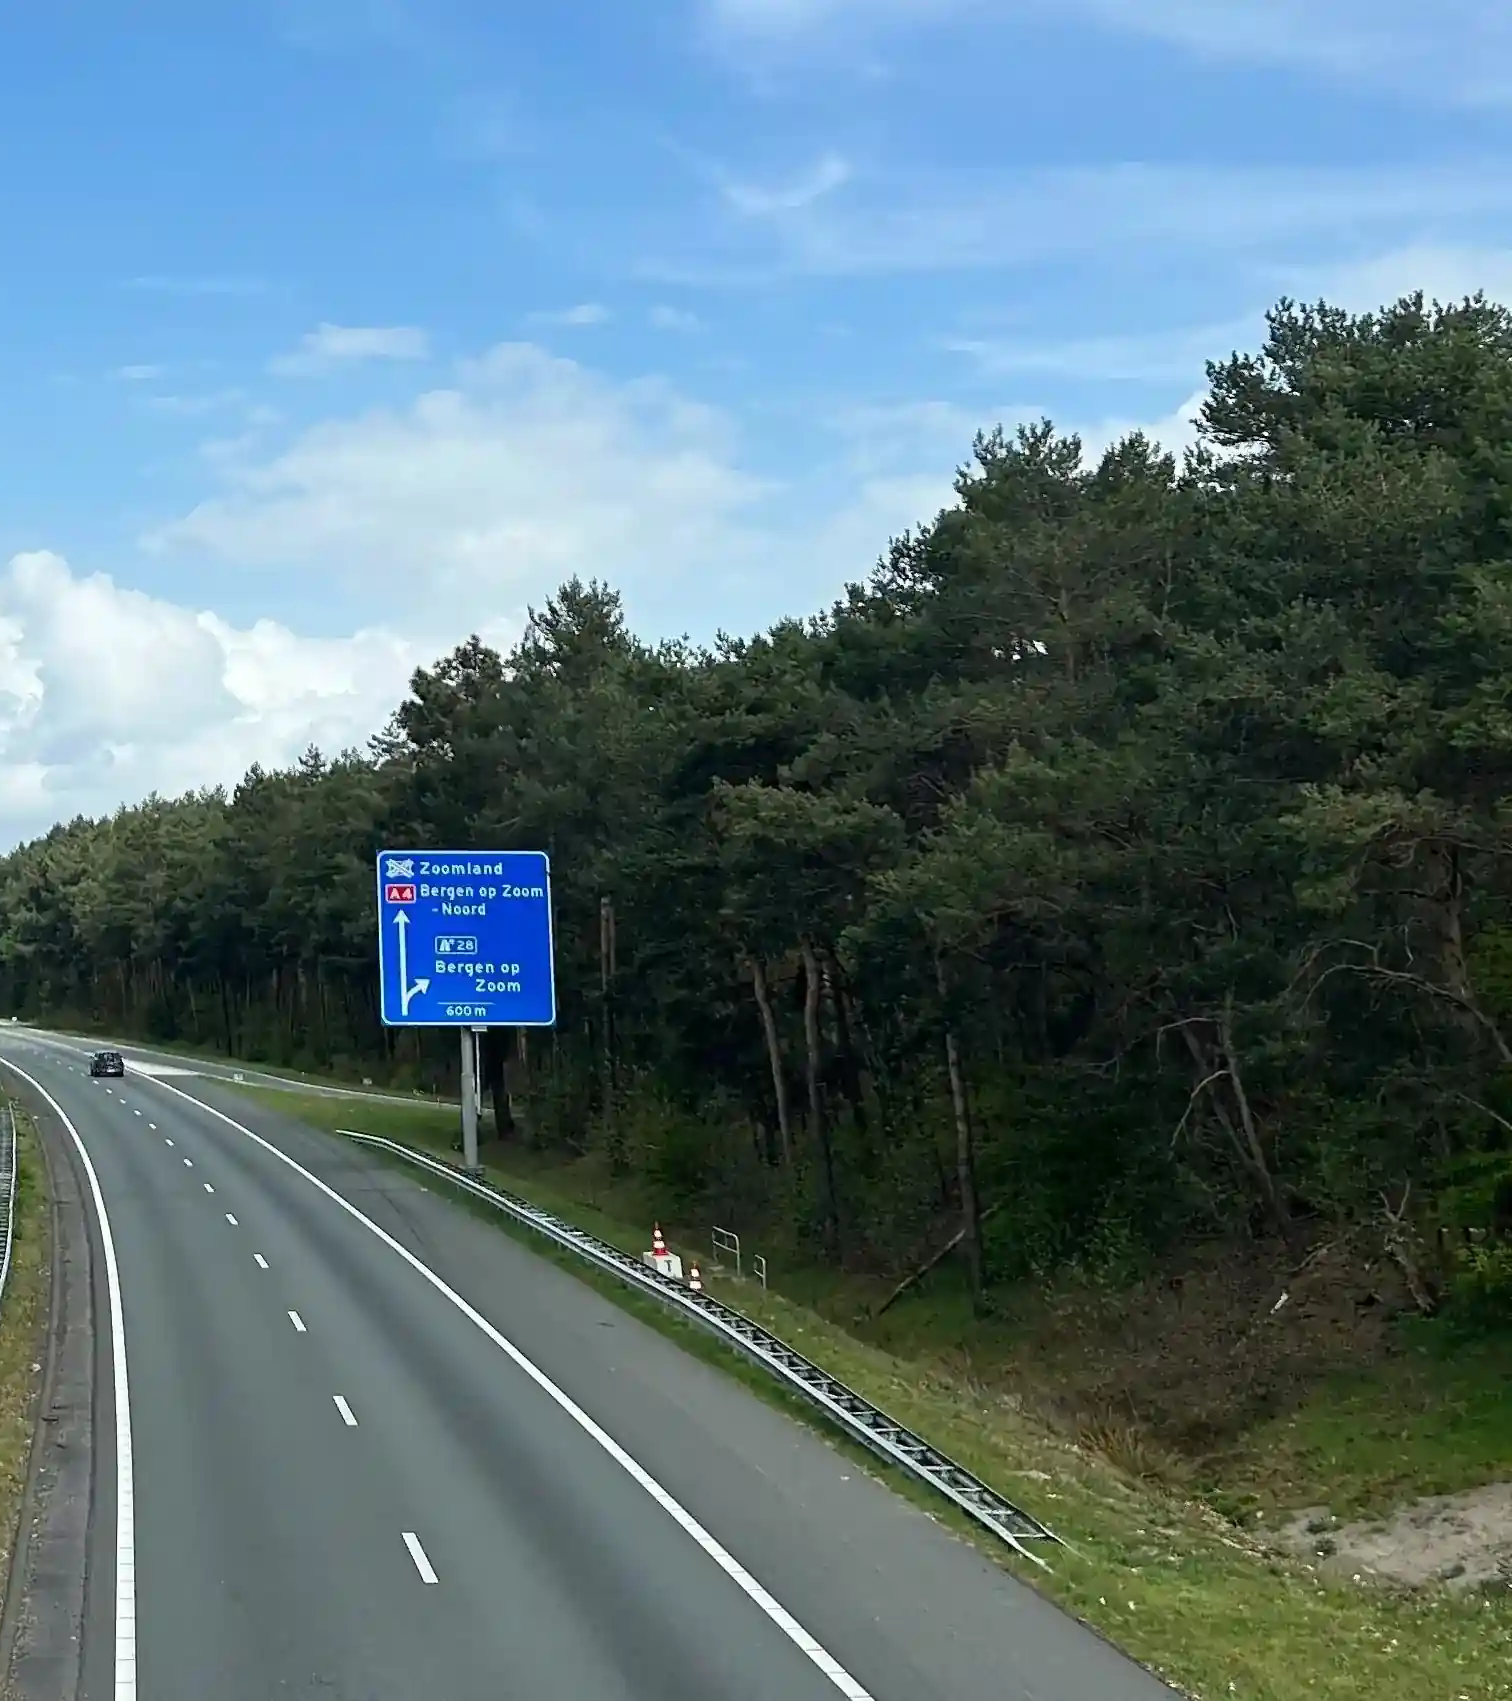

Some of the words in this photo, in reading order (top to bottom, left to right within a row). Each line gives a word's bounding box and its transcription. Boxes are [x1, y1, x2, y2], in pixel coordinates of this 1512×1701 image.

[419, 862, 503, 875] Zoomland
[389, 887, 413, 900] A4
[420, 884, 474, 900] Bergen
[479, 886, 496, 899] op
[502, 885, 544, 897] Zoom
[456, 939, 474, 951] 28
[435, 960, 495, 977] Bergen
[500, 962, 520, 976] op
[475, 979, 521, 992] Zoom
[445, 1005, 472, 1017] 600
[474, 1007, 486, 1017] m
